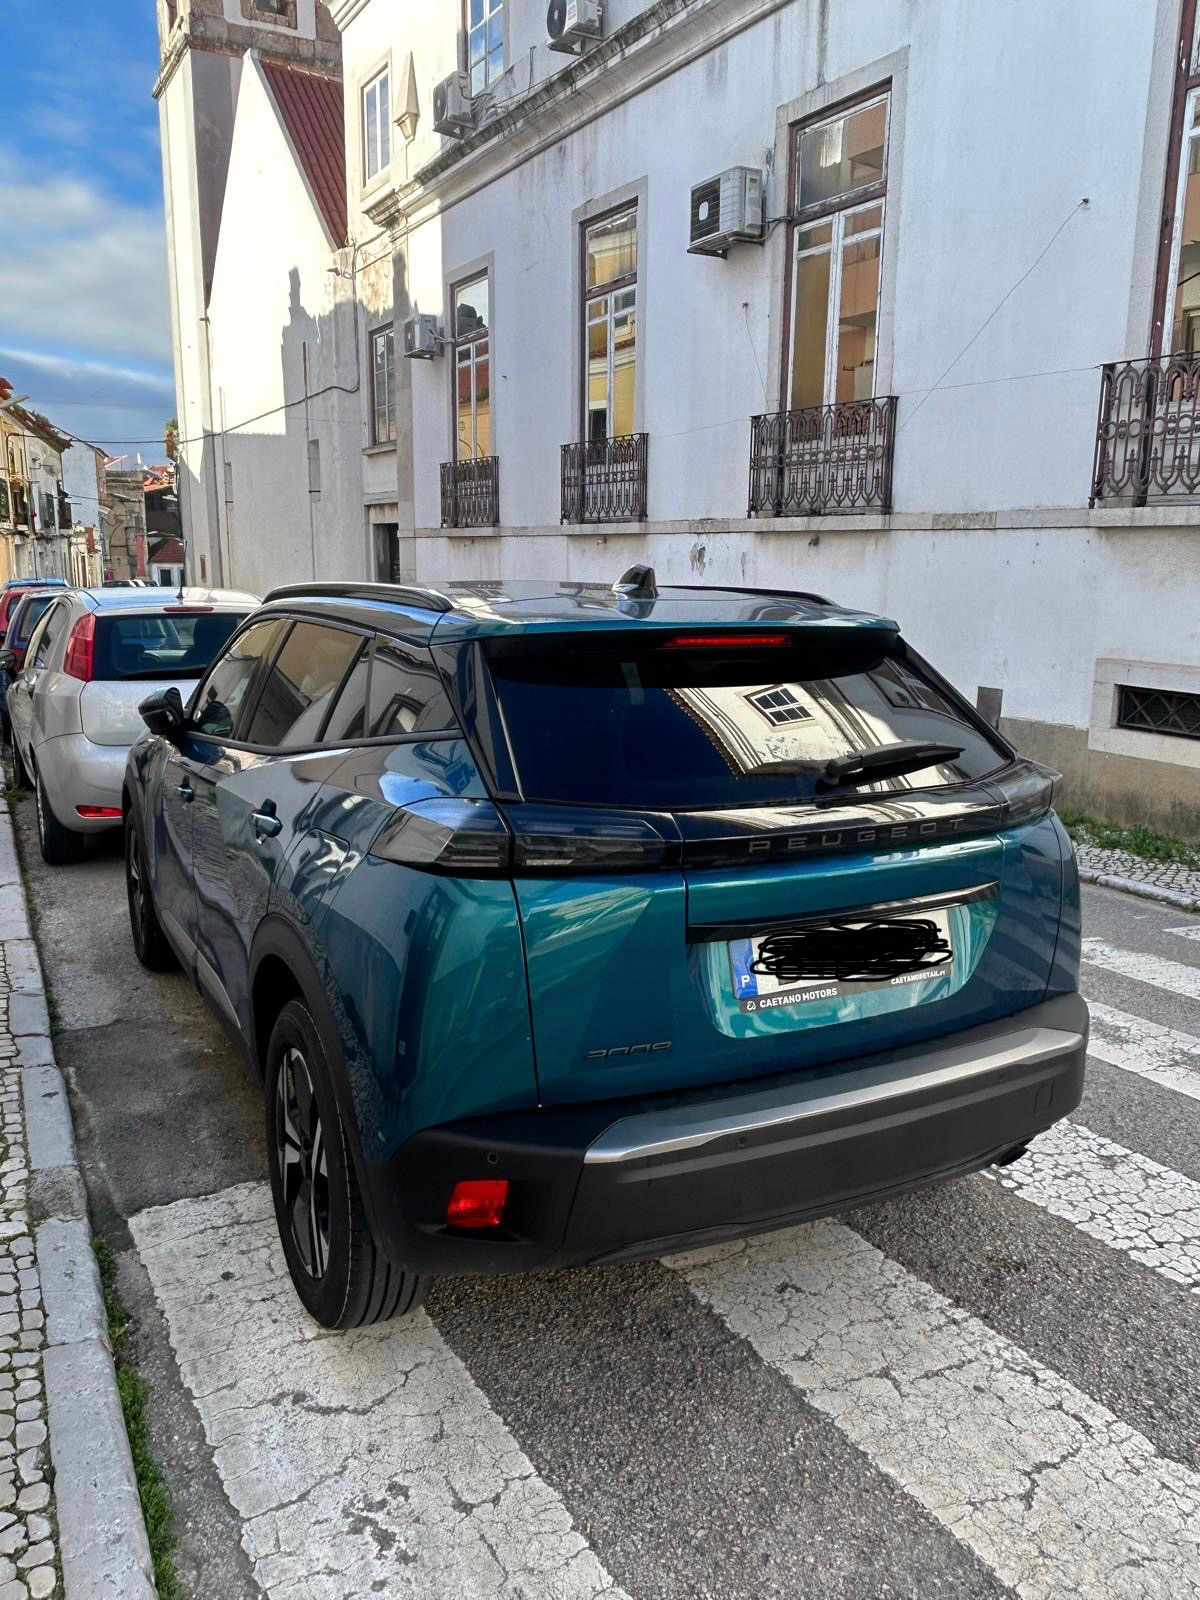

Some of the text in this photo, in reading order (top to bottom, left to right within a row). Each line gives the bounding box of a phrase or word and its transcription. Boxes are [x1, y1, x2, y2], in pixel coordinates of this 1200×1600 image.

[749, 818, 963, 852] PEUGEOT
[741, 975, 750, 988] P
[759, 988, 838, 1008] CAETANO MOTORS
